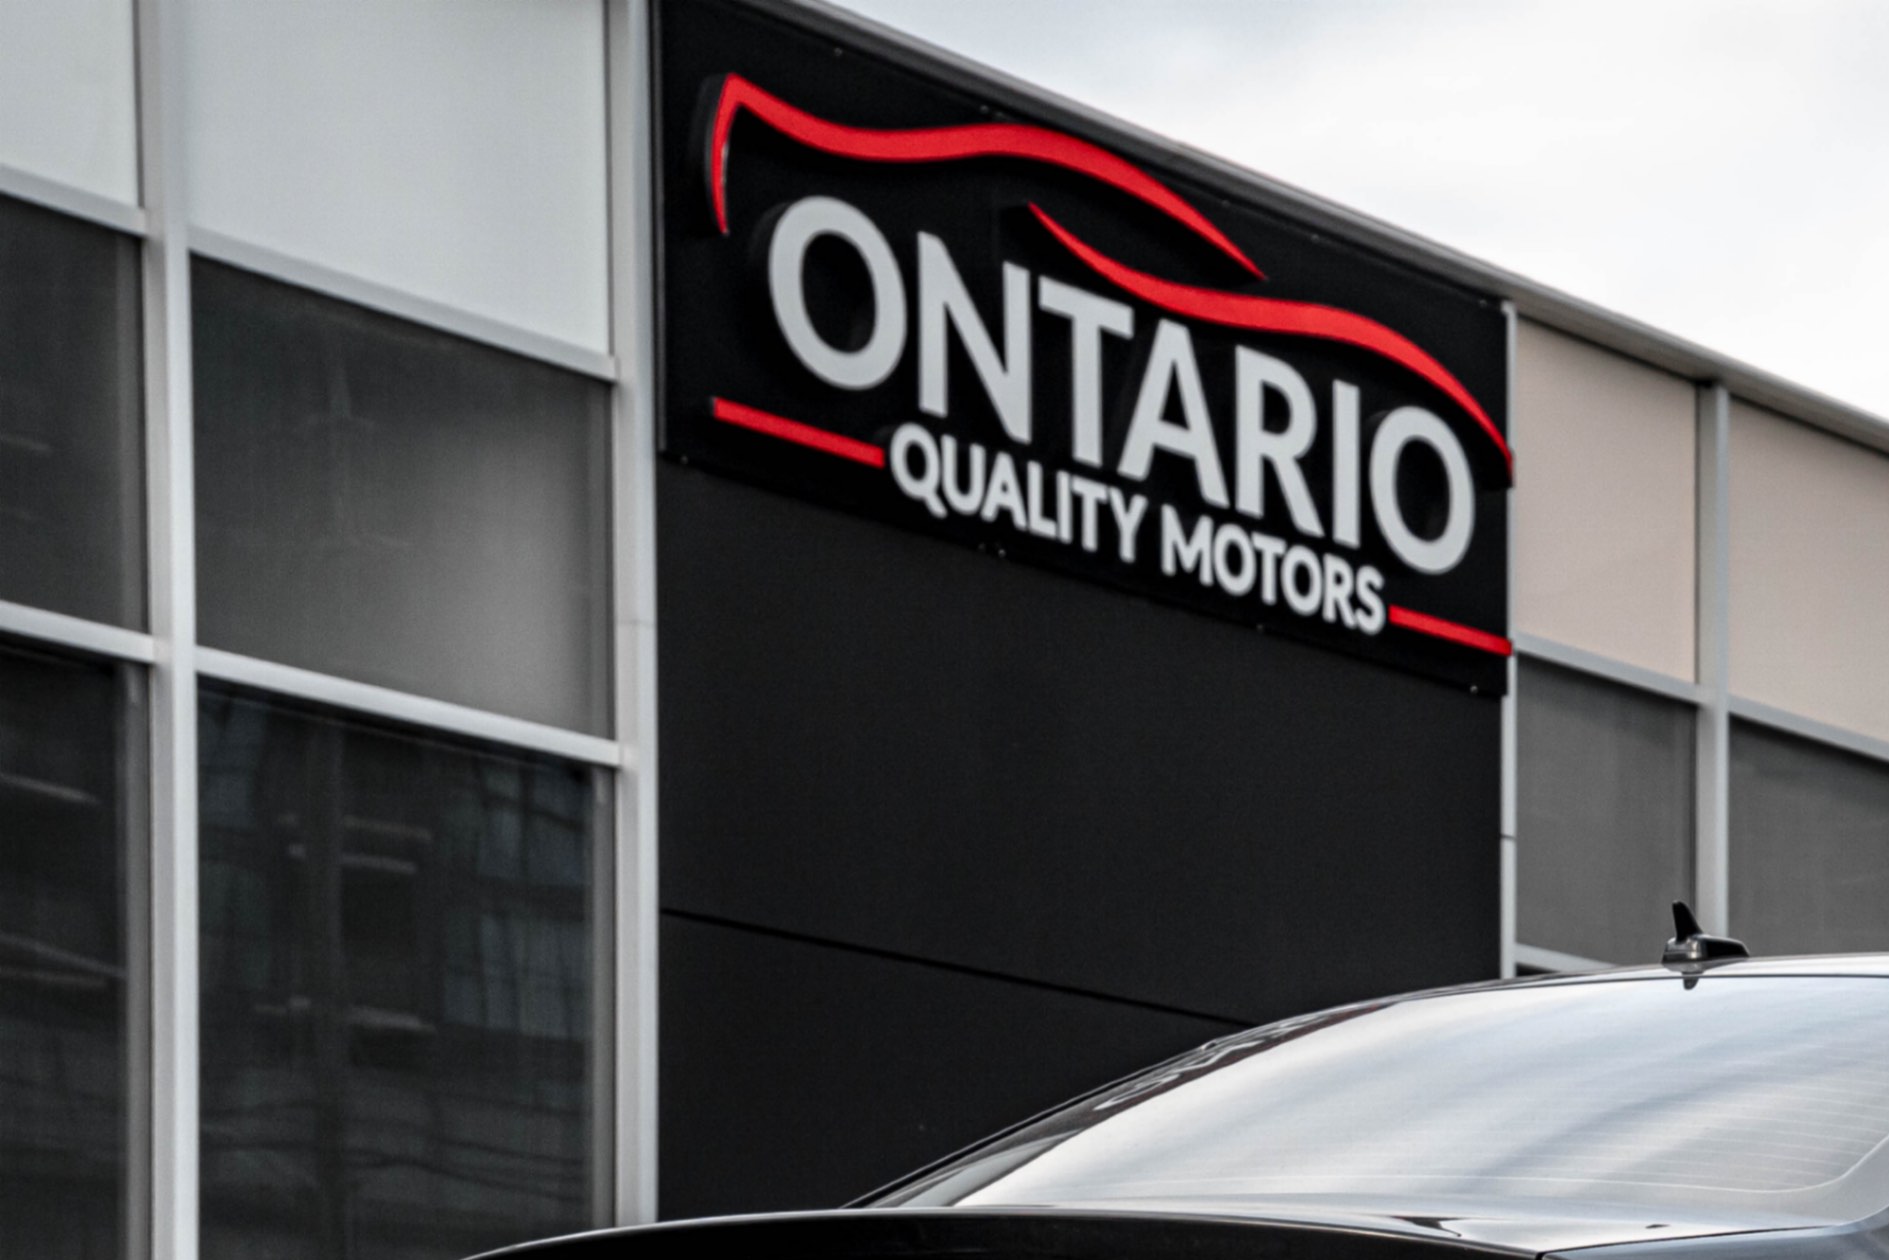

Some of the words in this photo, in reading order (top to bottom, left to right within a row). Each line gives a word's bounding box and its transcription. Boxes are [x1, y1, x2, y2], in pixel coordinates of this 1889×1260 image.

[769, 195, 1475, 574] ONTARIO
[890, 423, 1148, 562] QUALITY
[1161, 505, 1386, 634] MOTORS
